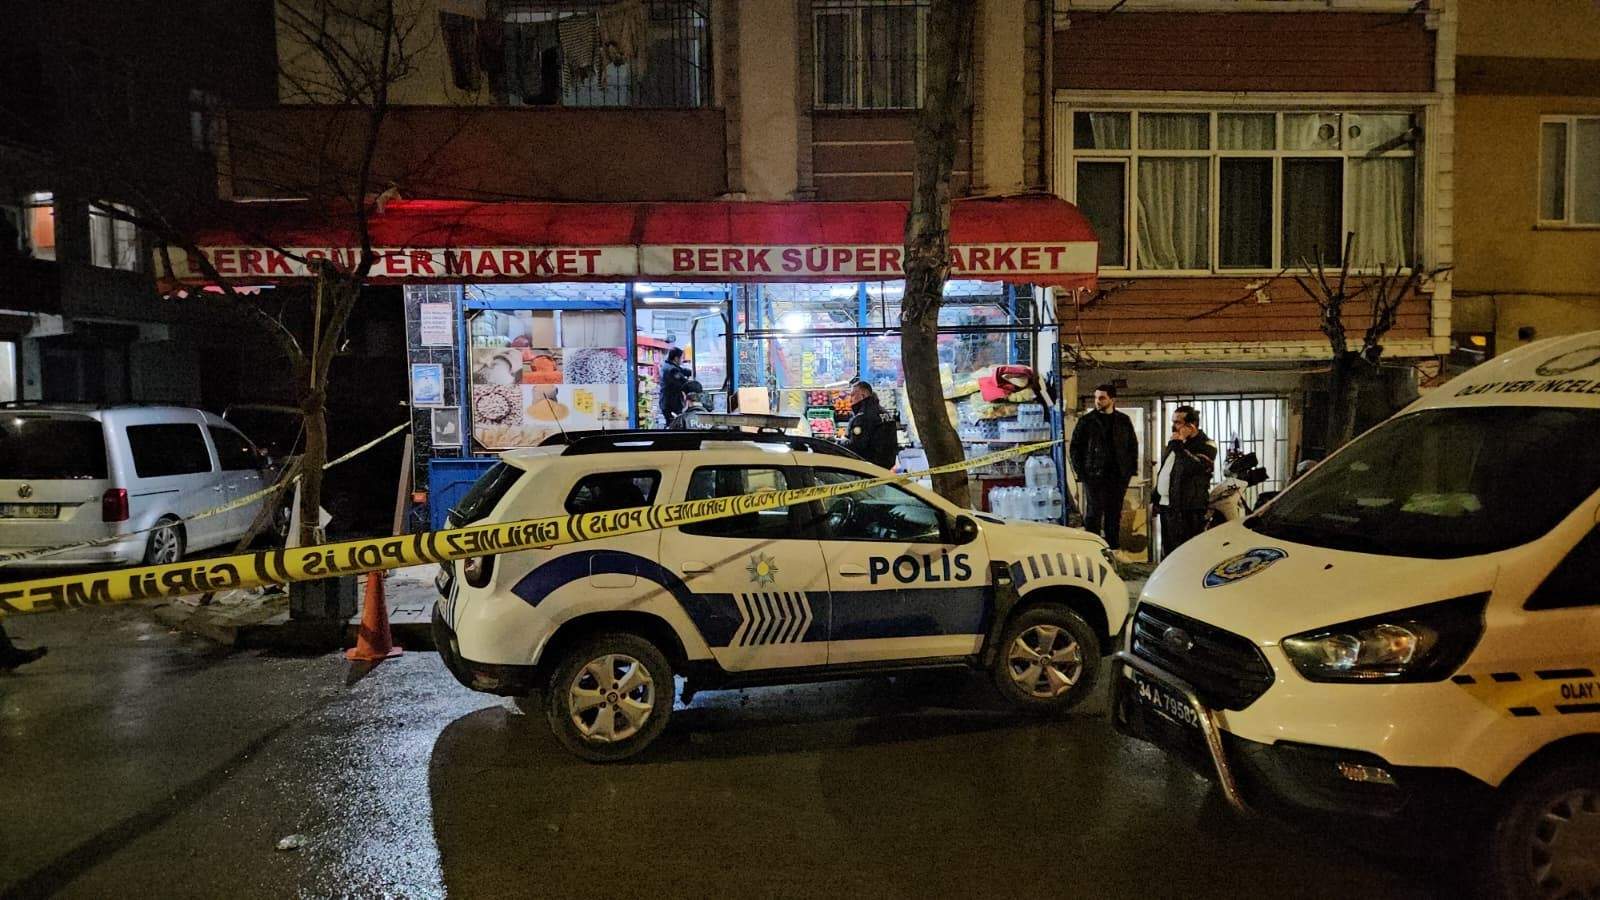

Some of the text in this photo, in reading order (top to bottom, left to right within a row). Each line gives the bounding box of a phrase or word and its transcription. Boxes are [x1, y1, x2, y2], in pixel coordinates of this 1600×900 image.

[443, 249, 602, 274] MARKET
[672, 245, 1066, 272] BERK SÜPER ARKET
[869, 548, 973, 585] POLİS
